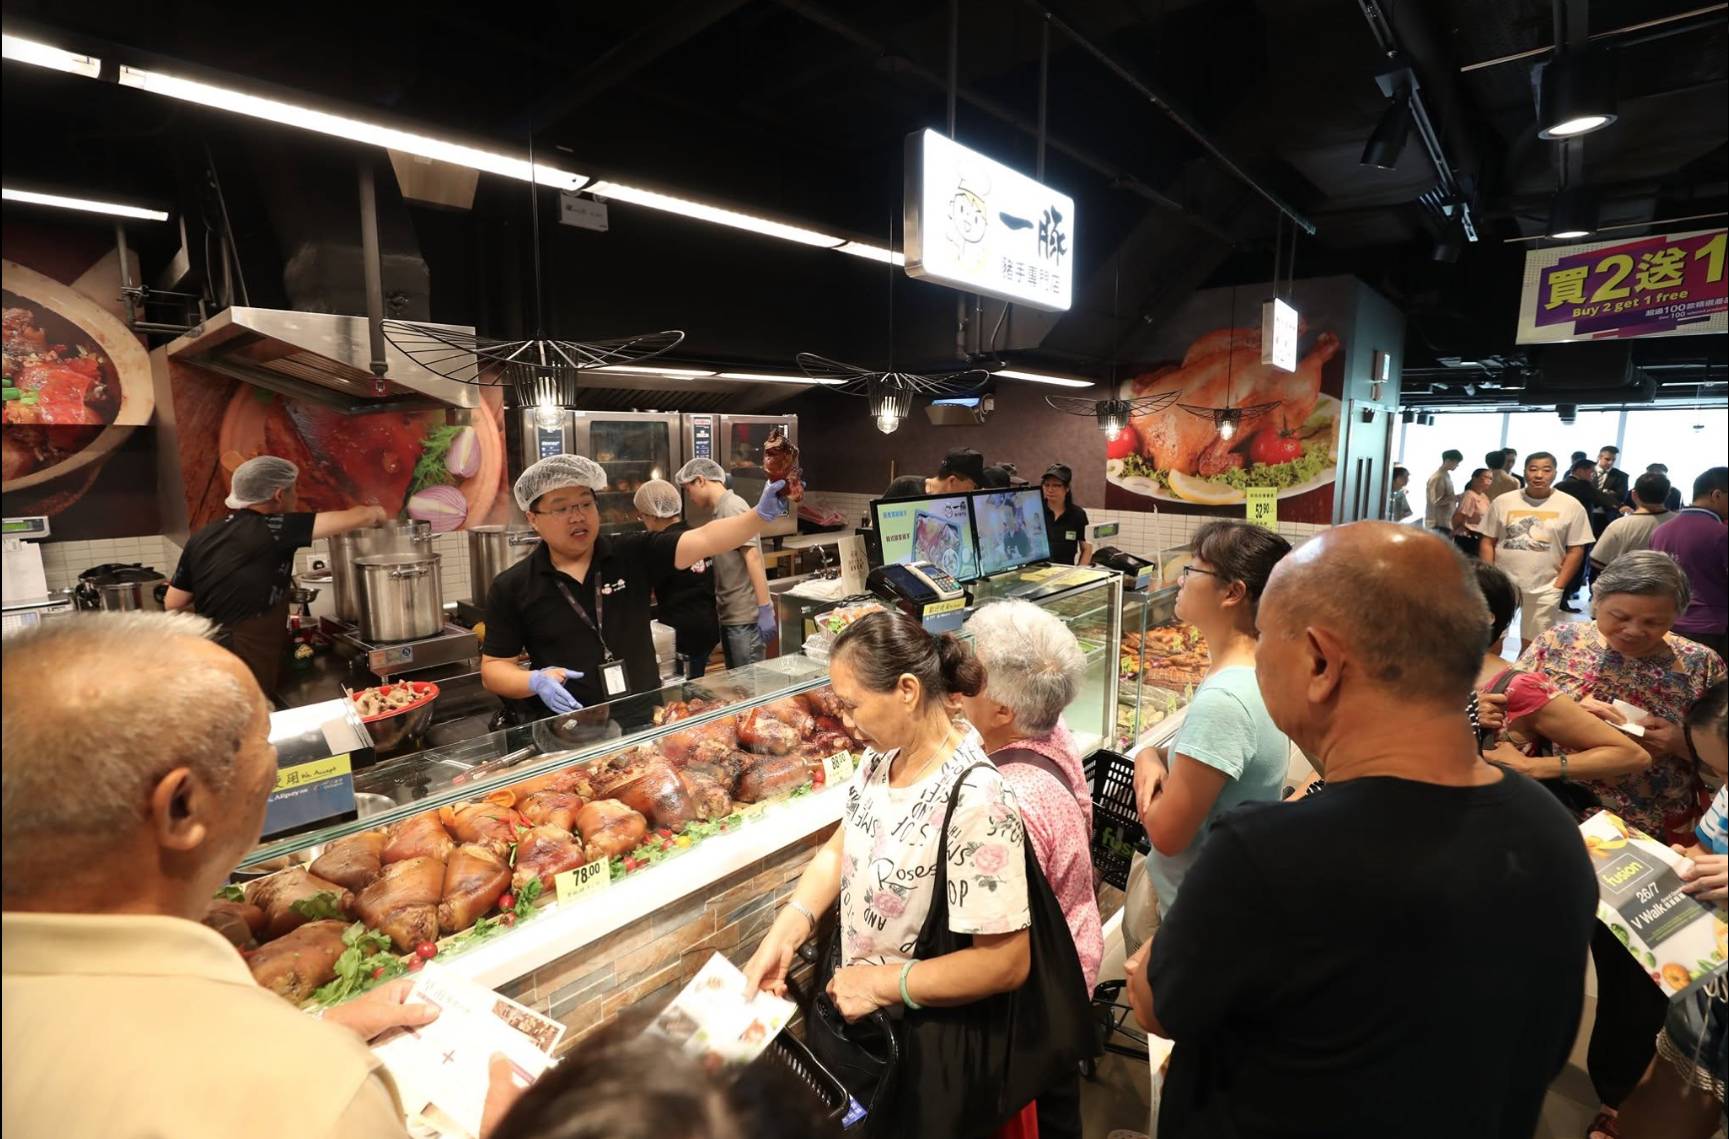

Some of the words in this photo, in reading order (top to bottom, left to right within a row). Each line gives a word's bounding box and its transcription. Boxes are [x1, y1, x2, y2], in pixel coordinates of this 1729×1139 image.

[1544, 234, 1728, 310] 買2送1
[1573, 305, 1599, 318] Buy
[1603, 302, 1612, 312] 2
[1614, 299, 1639, 313] get
[1644, 295, 1651, 305] 1
[1656, 289, 1689, 304] free
[871, 857, 937, 890] Roses
[1603, 860, 1643, 887] fusion
[1636, 882, 1660, 905] 26/7
[1631, 915, 1642, 930] V
[1640, 904, 1666, 925] Walk
